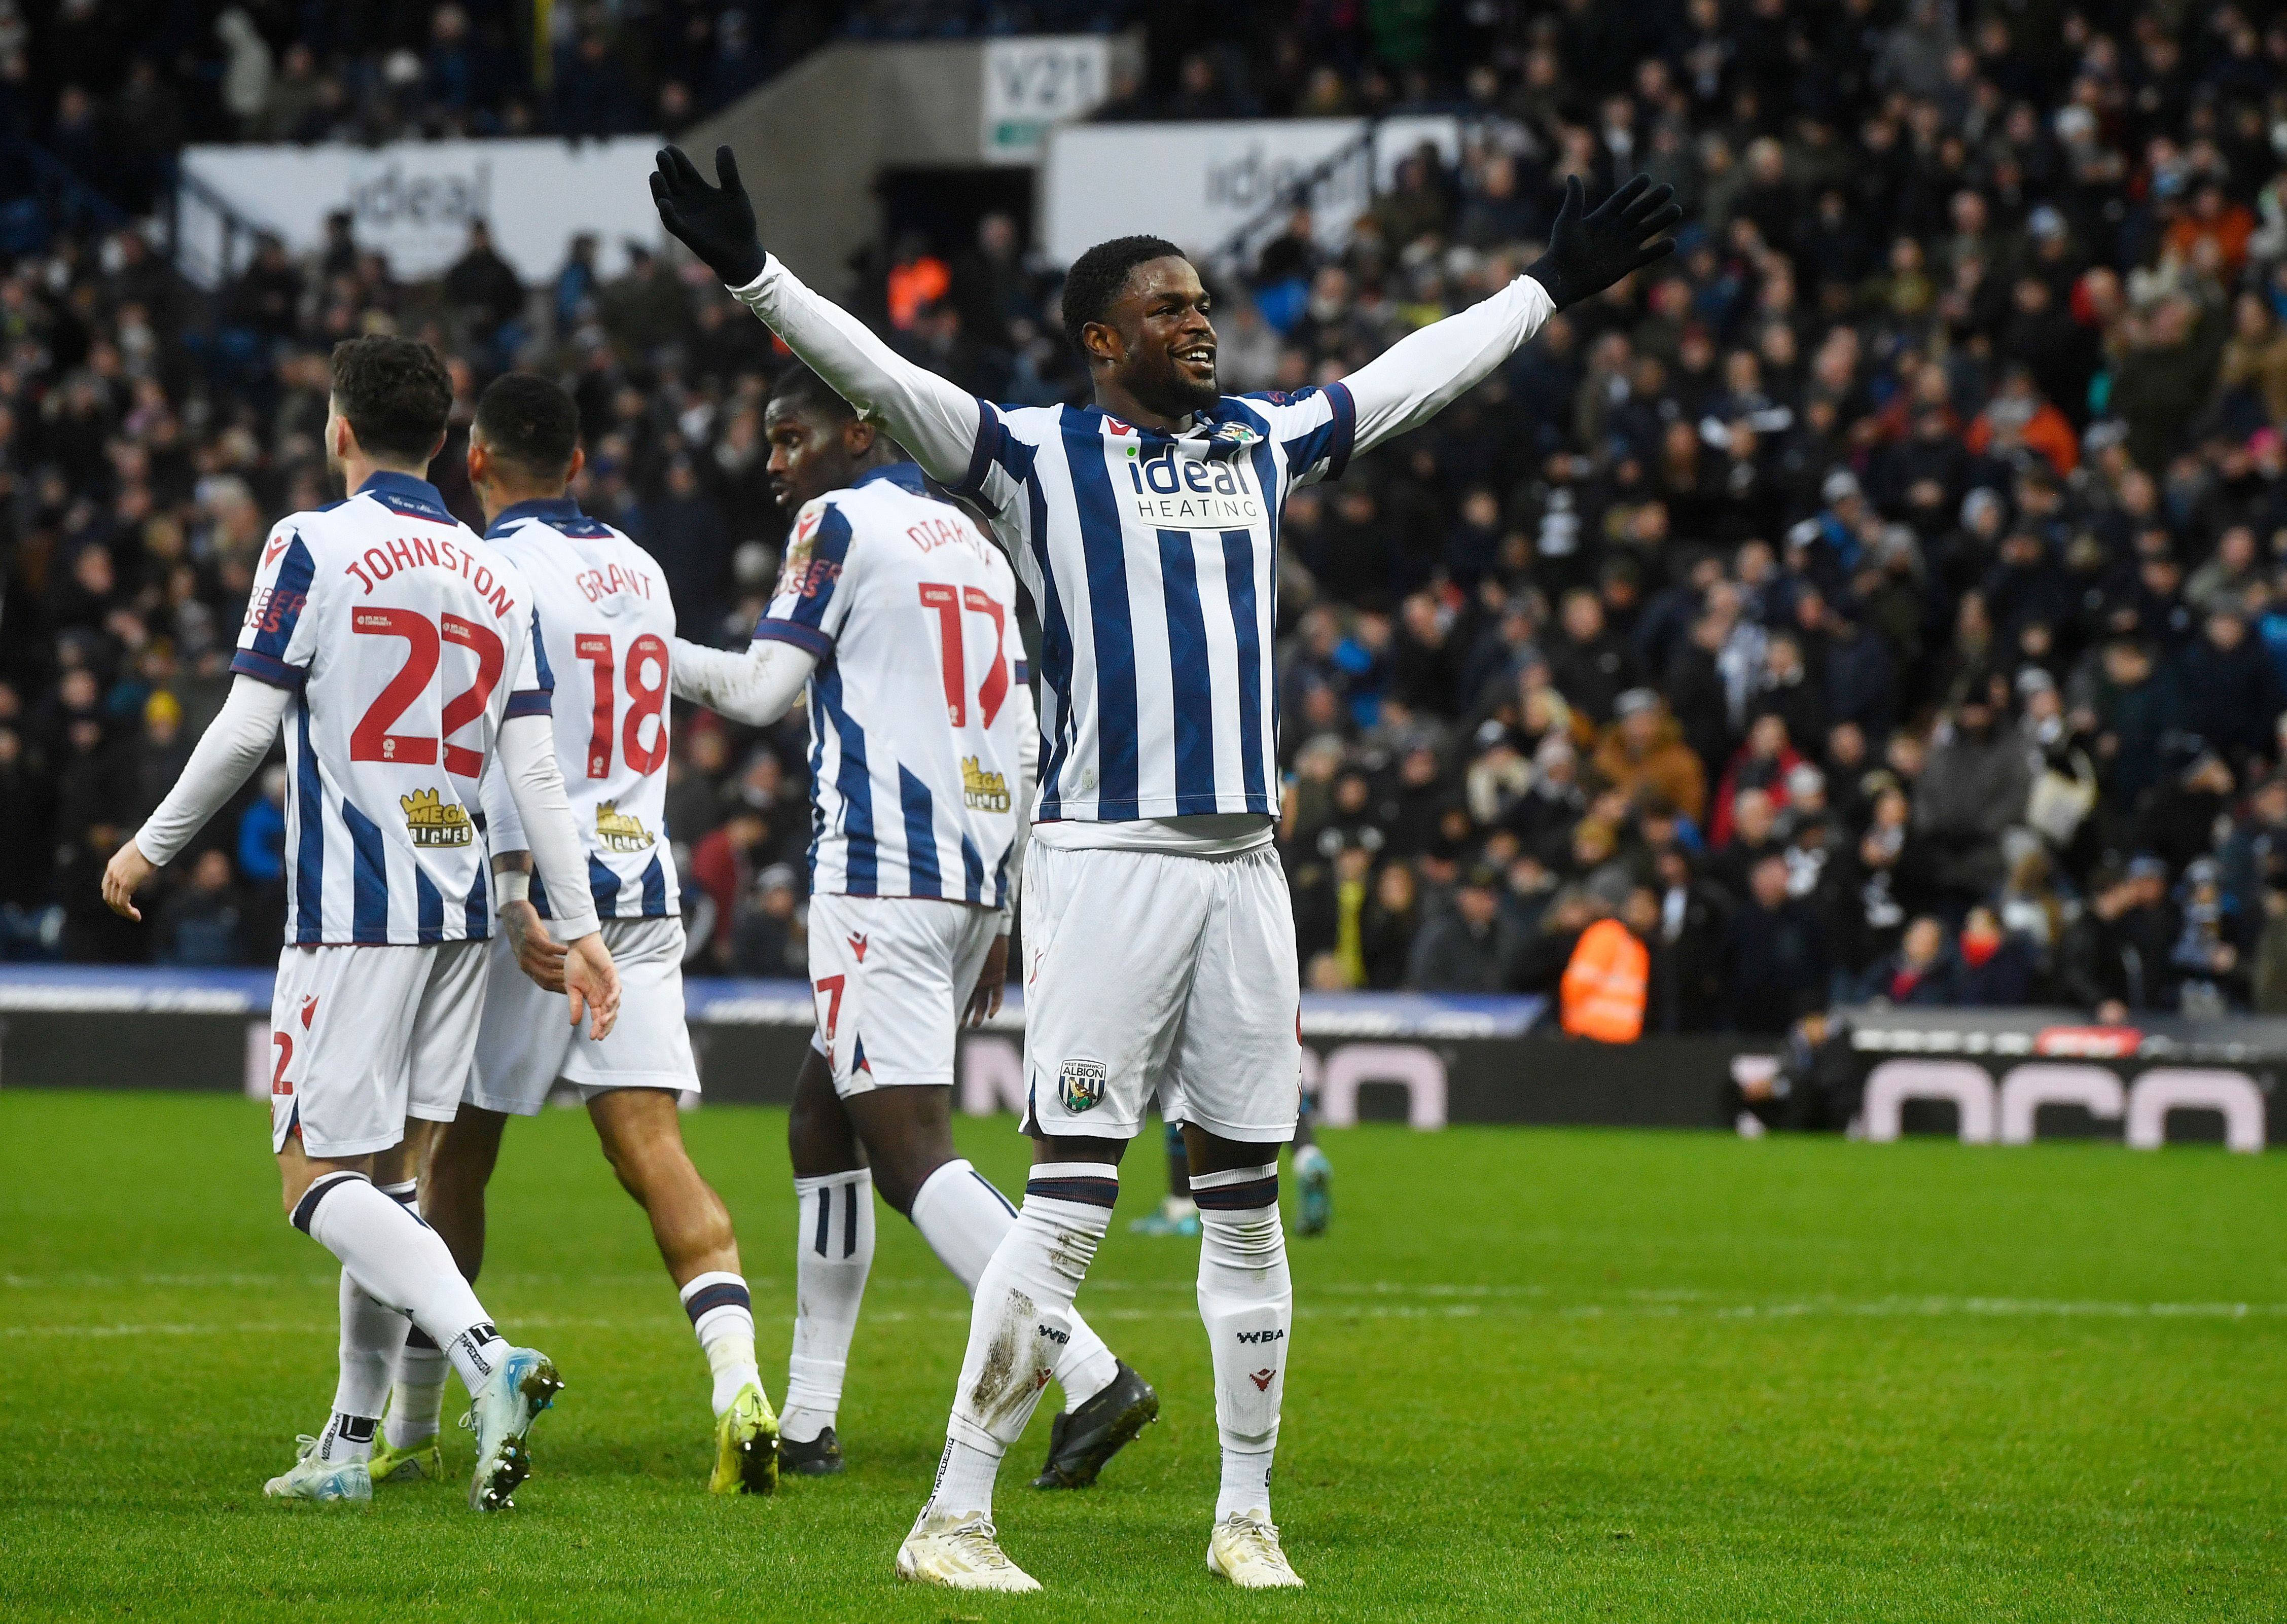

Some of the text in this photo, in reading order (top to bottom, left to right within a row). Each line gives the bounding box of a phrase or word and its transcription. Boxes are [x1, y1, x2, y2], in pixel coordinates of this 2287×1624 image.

[1126, 445, 1250, 495] ideal
[1139, 499, 1257, 518] HEATING
[345, 537, 514, 619] JOHNSTON
[576, 563, 651, 603] GRANT
[918, 583, 1008, 730] 17
[350, 606, 505, 778] 22
[576, 633, 669, 778] 18
[409, 803, 467, 824] MEGA
[409, 827, 469, 844] RICHES
[813, 974, 845, 1040] 7
[1063, 1067, 1103, 1078] ALBION
[1237, 1329, 1283, 1344] WBA
